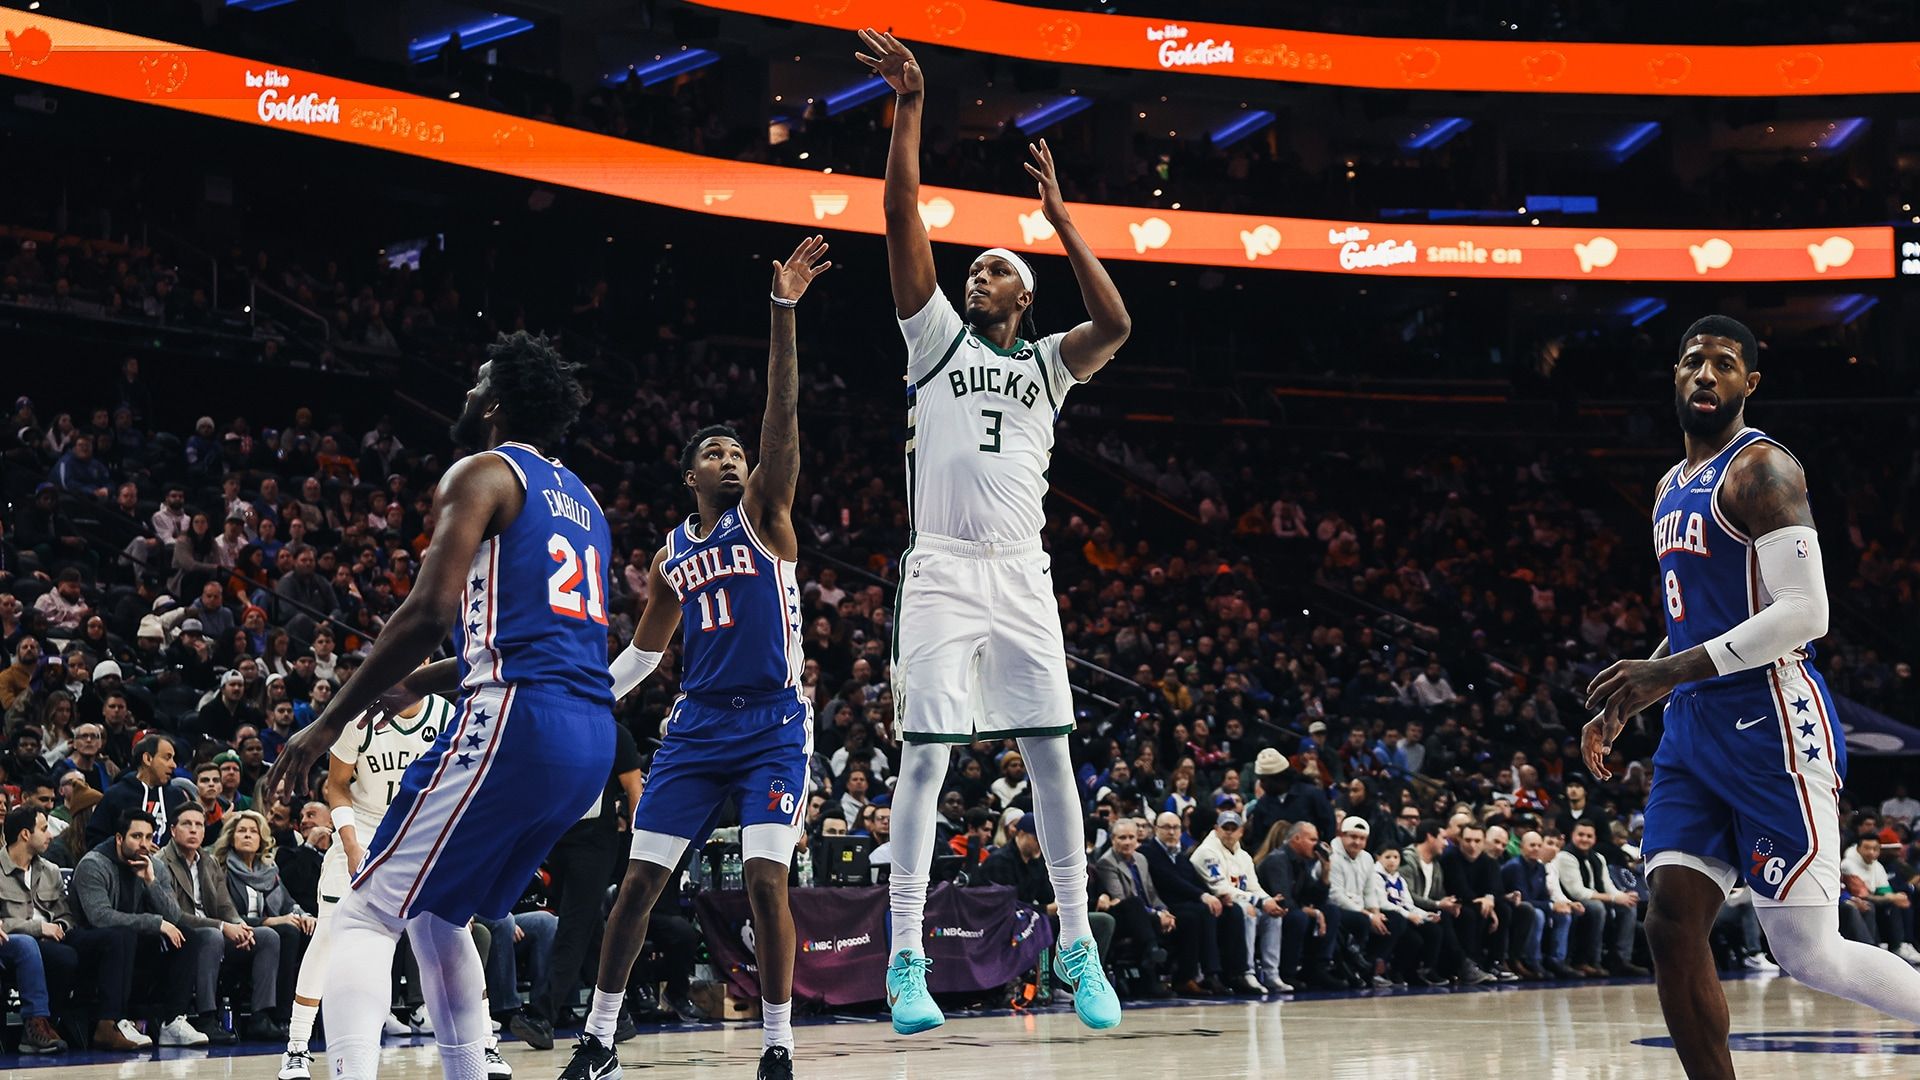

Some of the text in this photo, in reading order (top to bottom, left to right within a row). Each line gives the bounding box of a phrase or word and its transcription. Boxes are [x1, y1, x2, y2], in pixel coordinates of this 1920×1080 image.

[1158, 39, 1234, 68] Goldfish
[245, 69, 290, 88] be like
[258, 89, 340, 124] Goldfish
[1426, 240, 1488, 264] smile
[1492, 248, 1522, 264] on
[948, 366, 1040, 409] BUCKS
[979, 409, 1003, 453] 3
[542, 489, 591, 531] EMBIID
[548, 533, 609, 626] 21
[668, 544, 760, 604] PHILA
[697, 588, 735, 632] 11
[1665, 569, 1685, 622] 8
[366, 751, 420, 773] BUC
[386, 780, 401, 806] 1
[768, 790, 795, 814] 76
[1751, 851, 1786, 885] 76
[815, 933, 871, 951] NBC peacock
